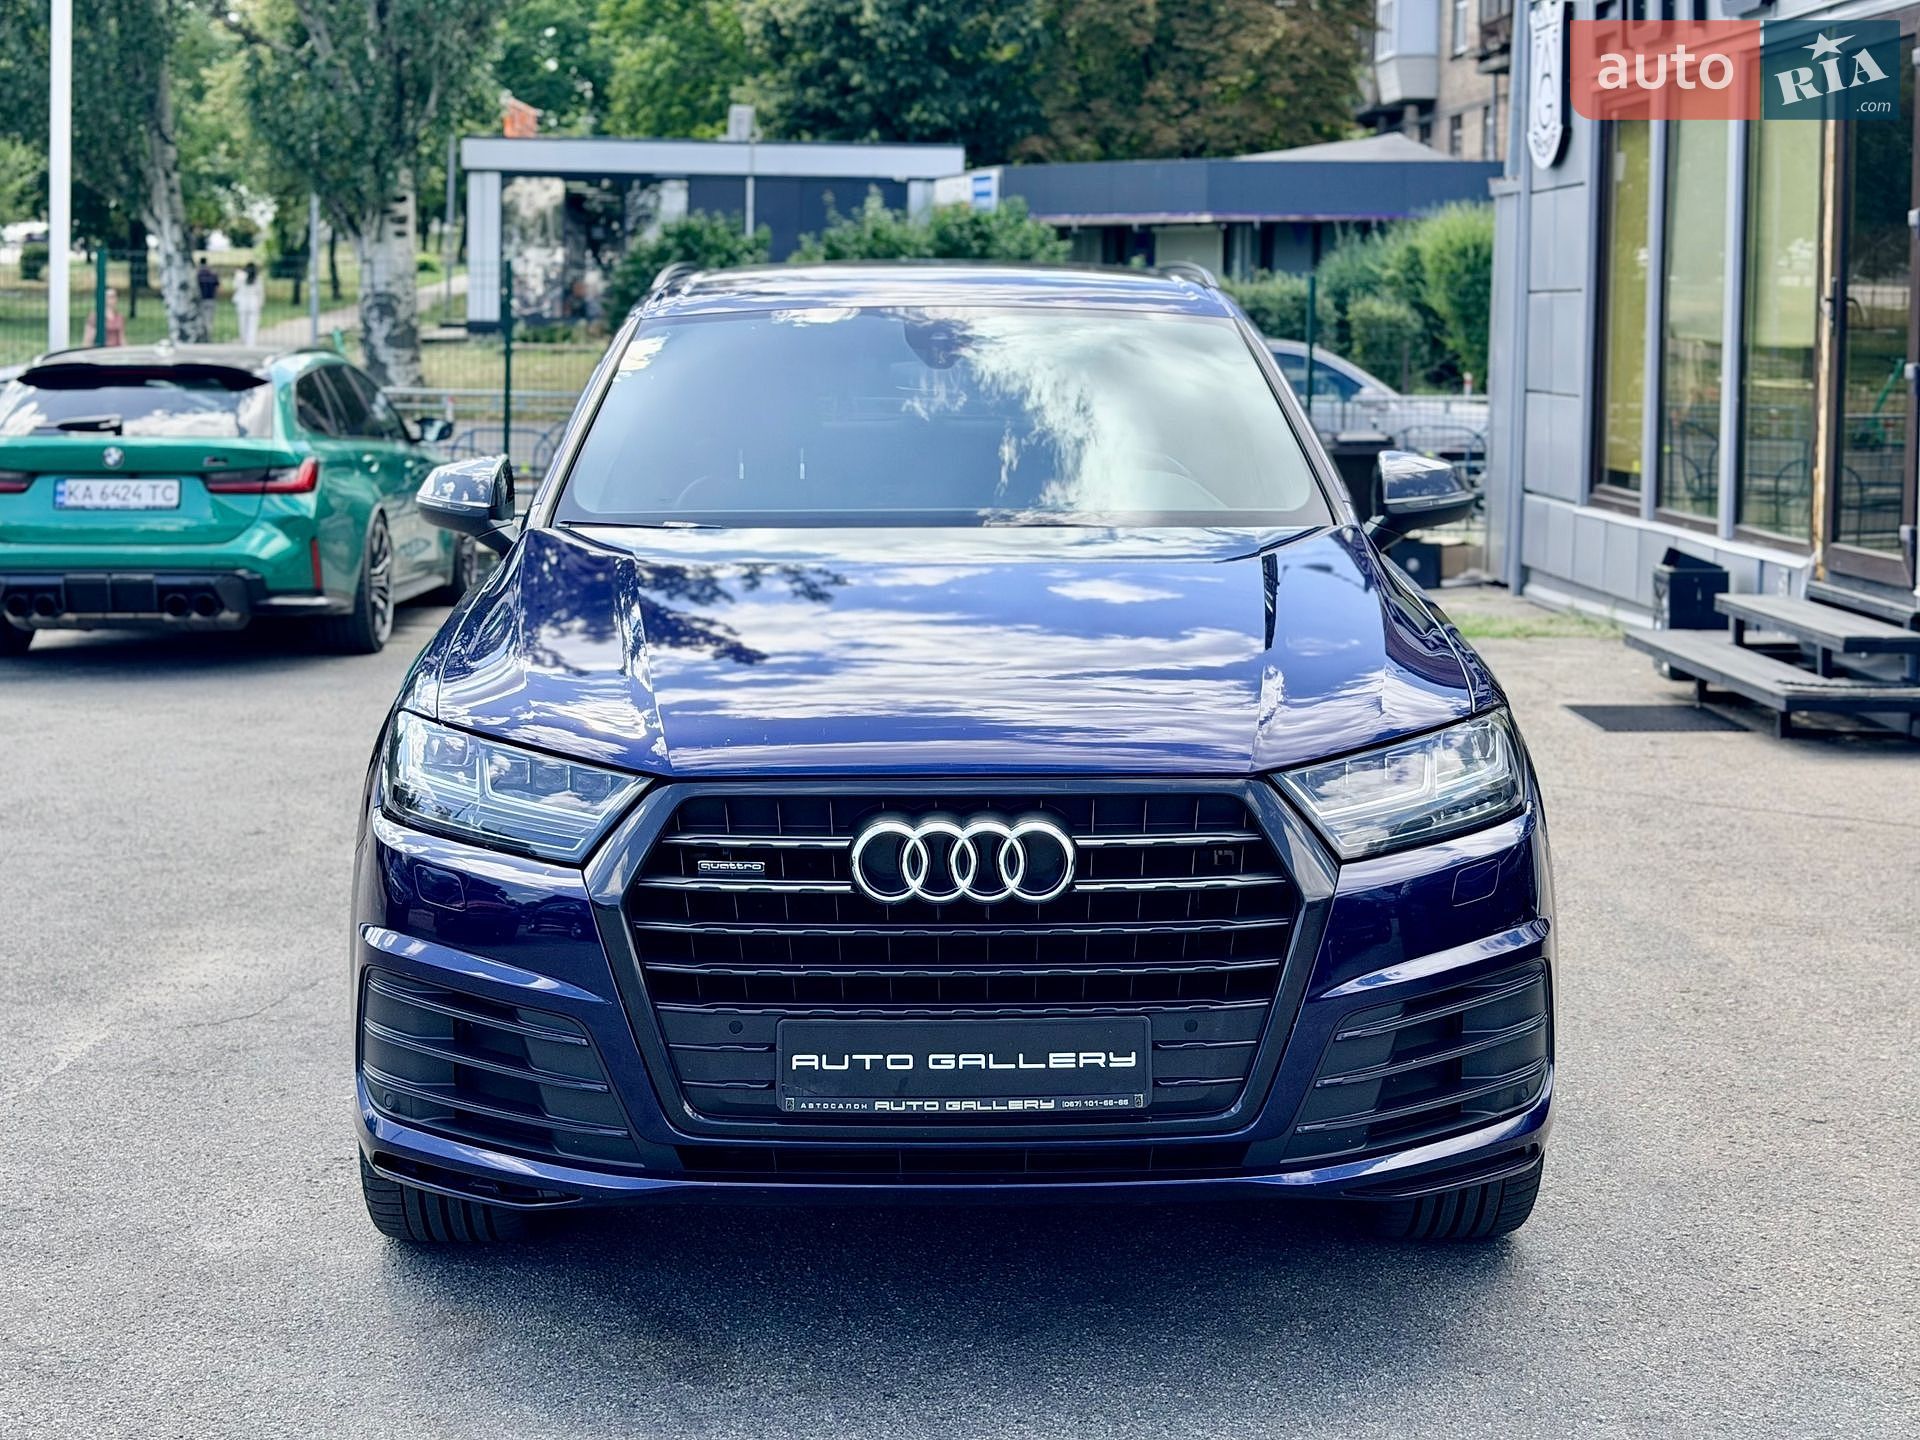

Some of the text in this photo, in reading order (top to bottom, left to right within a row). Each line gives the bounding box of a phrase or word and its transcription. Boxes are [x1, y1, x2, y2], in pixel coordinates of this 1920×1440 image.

[68, 485, 93, 501] KA
[101, 484, 142, 501] 6424
[149, 484, 175, 501] TC
[791, 1051, 1136, 1070] AUTO GALLERY
[875, 1101, 939, 1111] AUTO
[945, 1099, 1055, 1111] GALLERY
